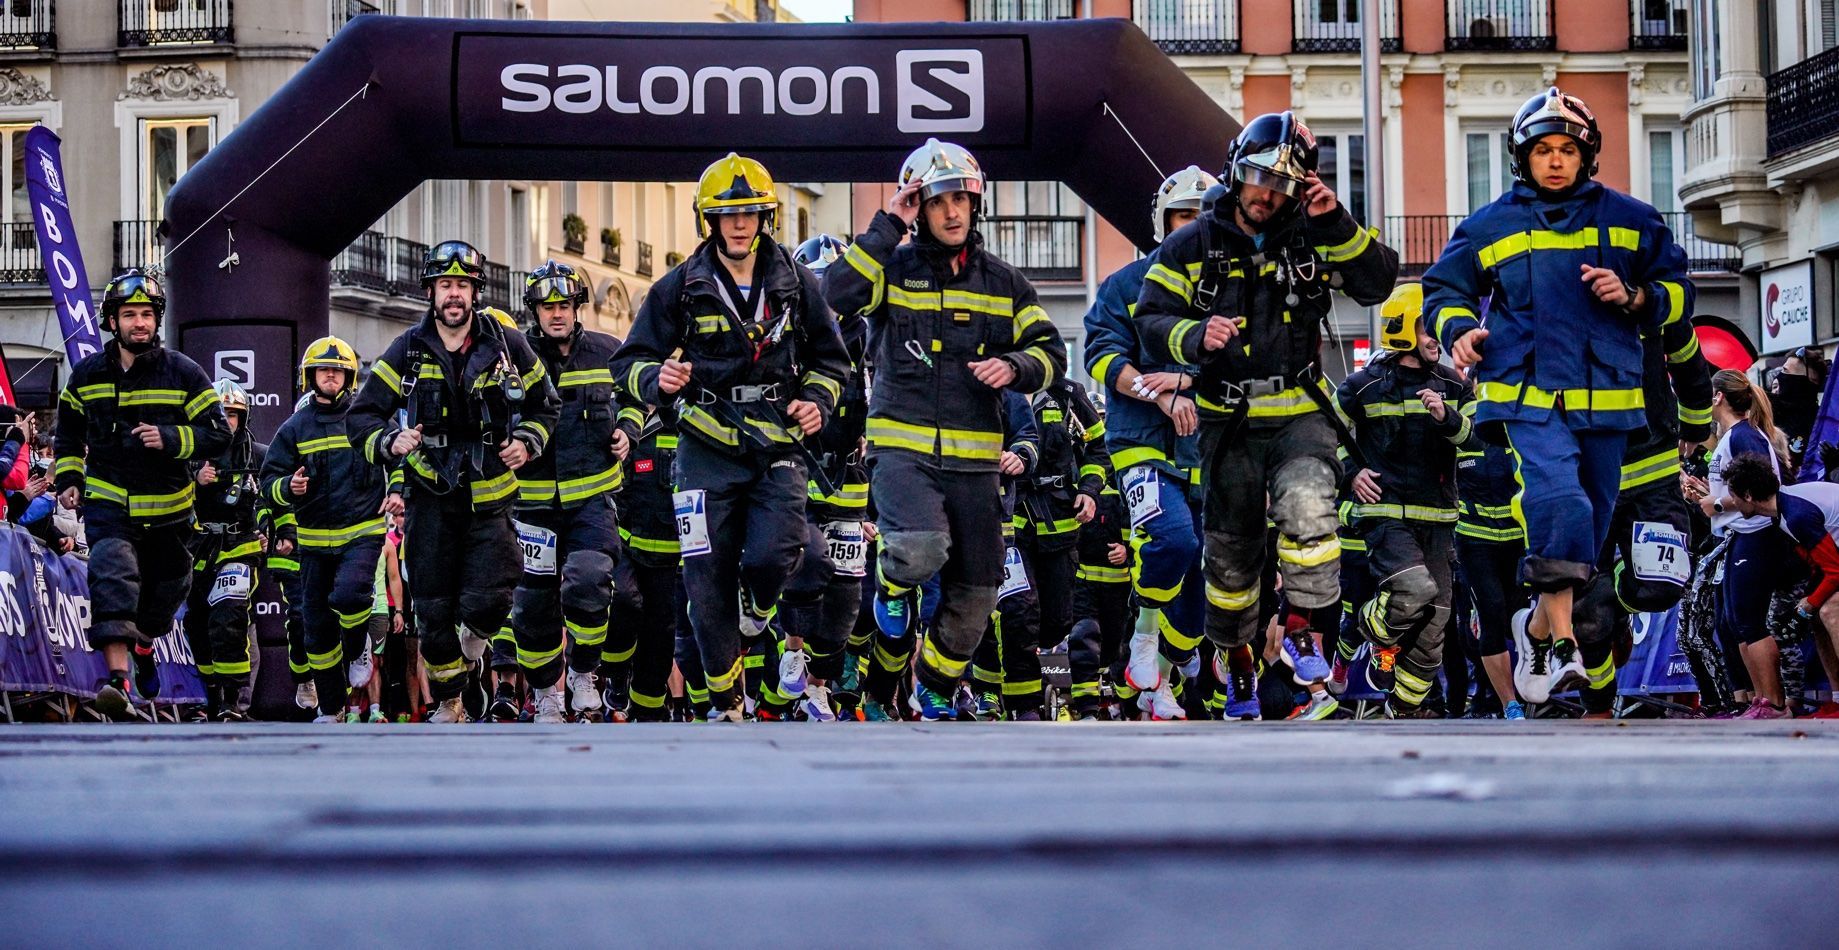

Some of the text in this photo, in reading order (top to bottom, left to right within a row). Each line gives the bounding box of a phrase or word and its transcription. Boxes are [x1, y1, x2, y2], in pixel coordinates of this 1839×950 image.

[1782, 285, 1804, 305] GRUPO
[829, 542, 862, 560] 1591
[1657, 545, 1675, 564] 74
